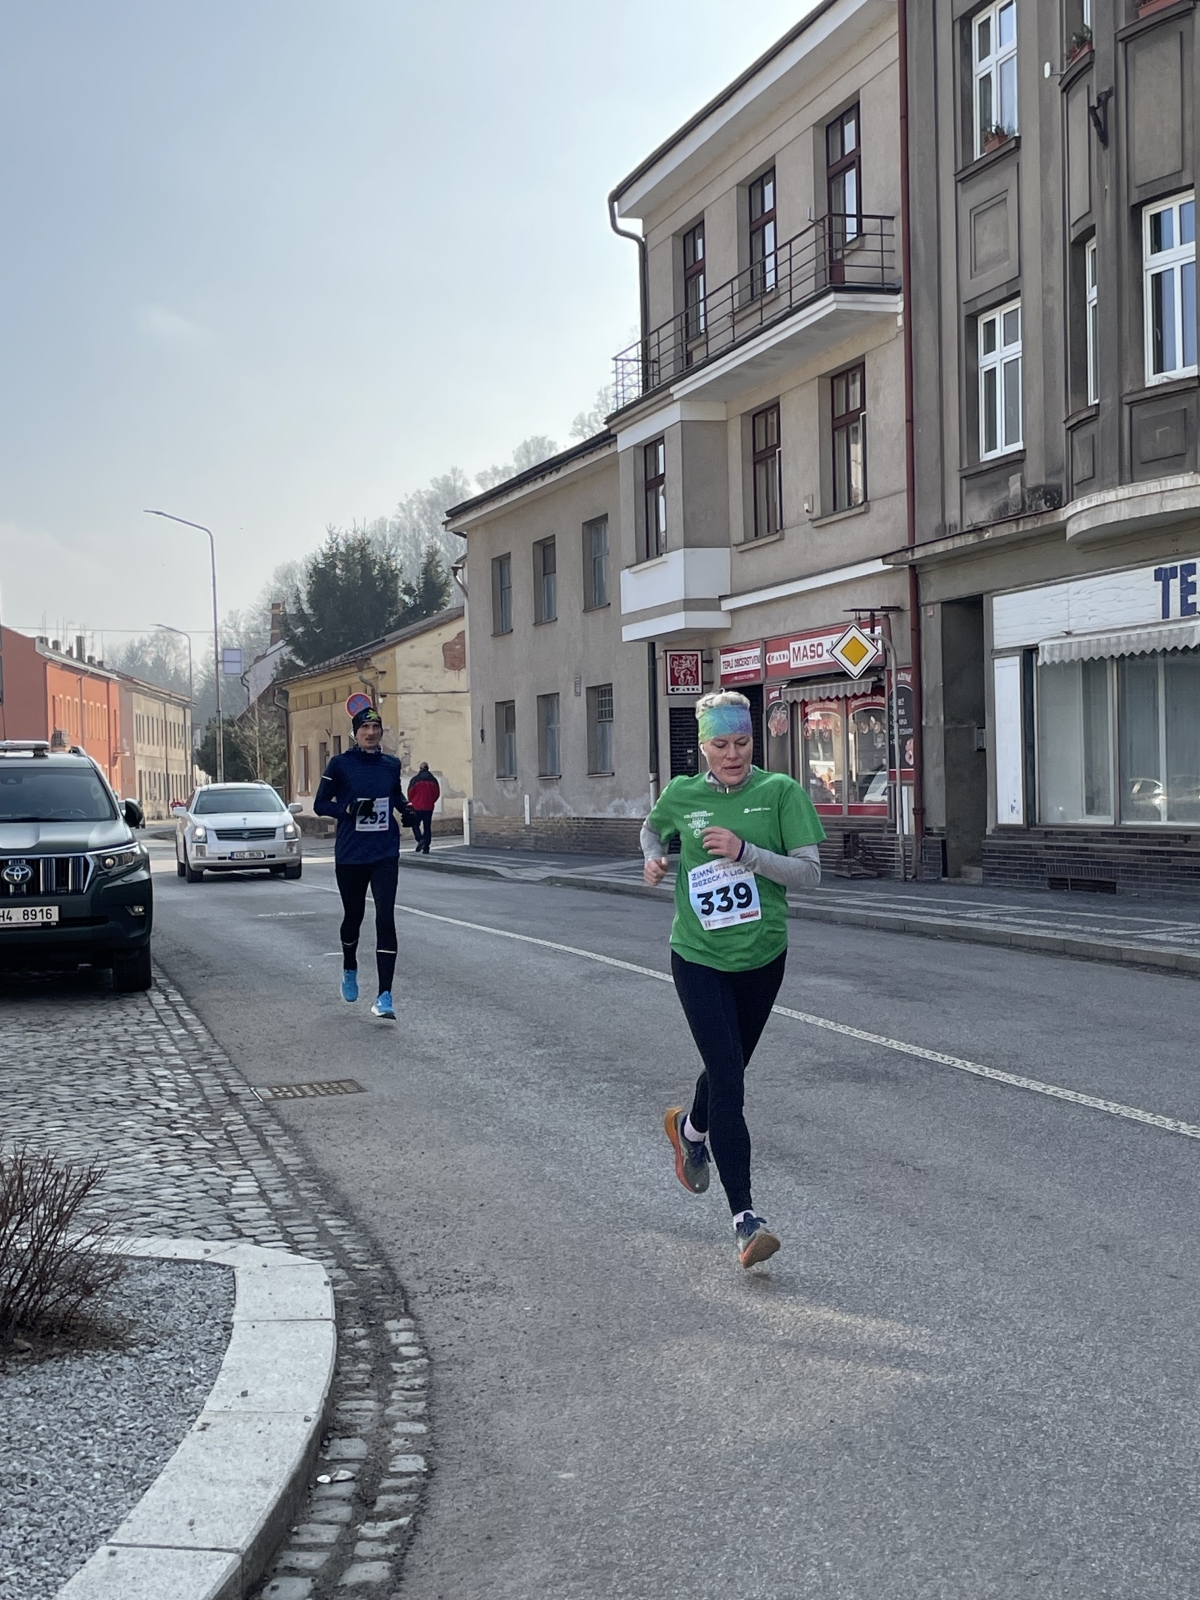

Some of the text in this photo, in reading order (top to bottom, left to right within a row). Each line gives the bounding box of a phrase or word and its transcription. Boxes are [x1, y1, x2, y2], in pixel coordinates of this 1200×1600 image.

[792, 642, 824, 662] MASO
[730, 868, 750, 877] LIGA
[697, 882, 752, 916] 339
[22, 908, 52, 921] 8916
